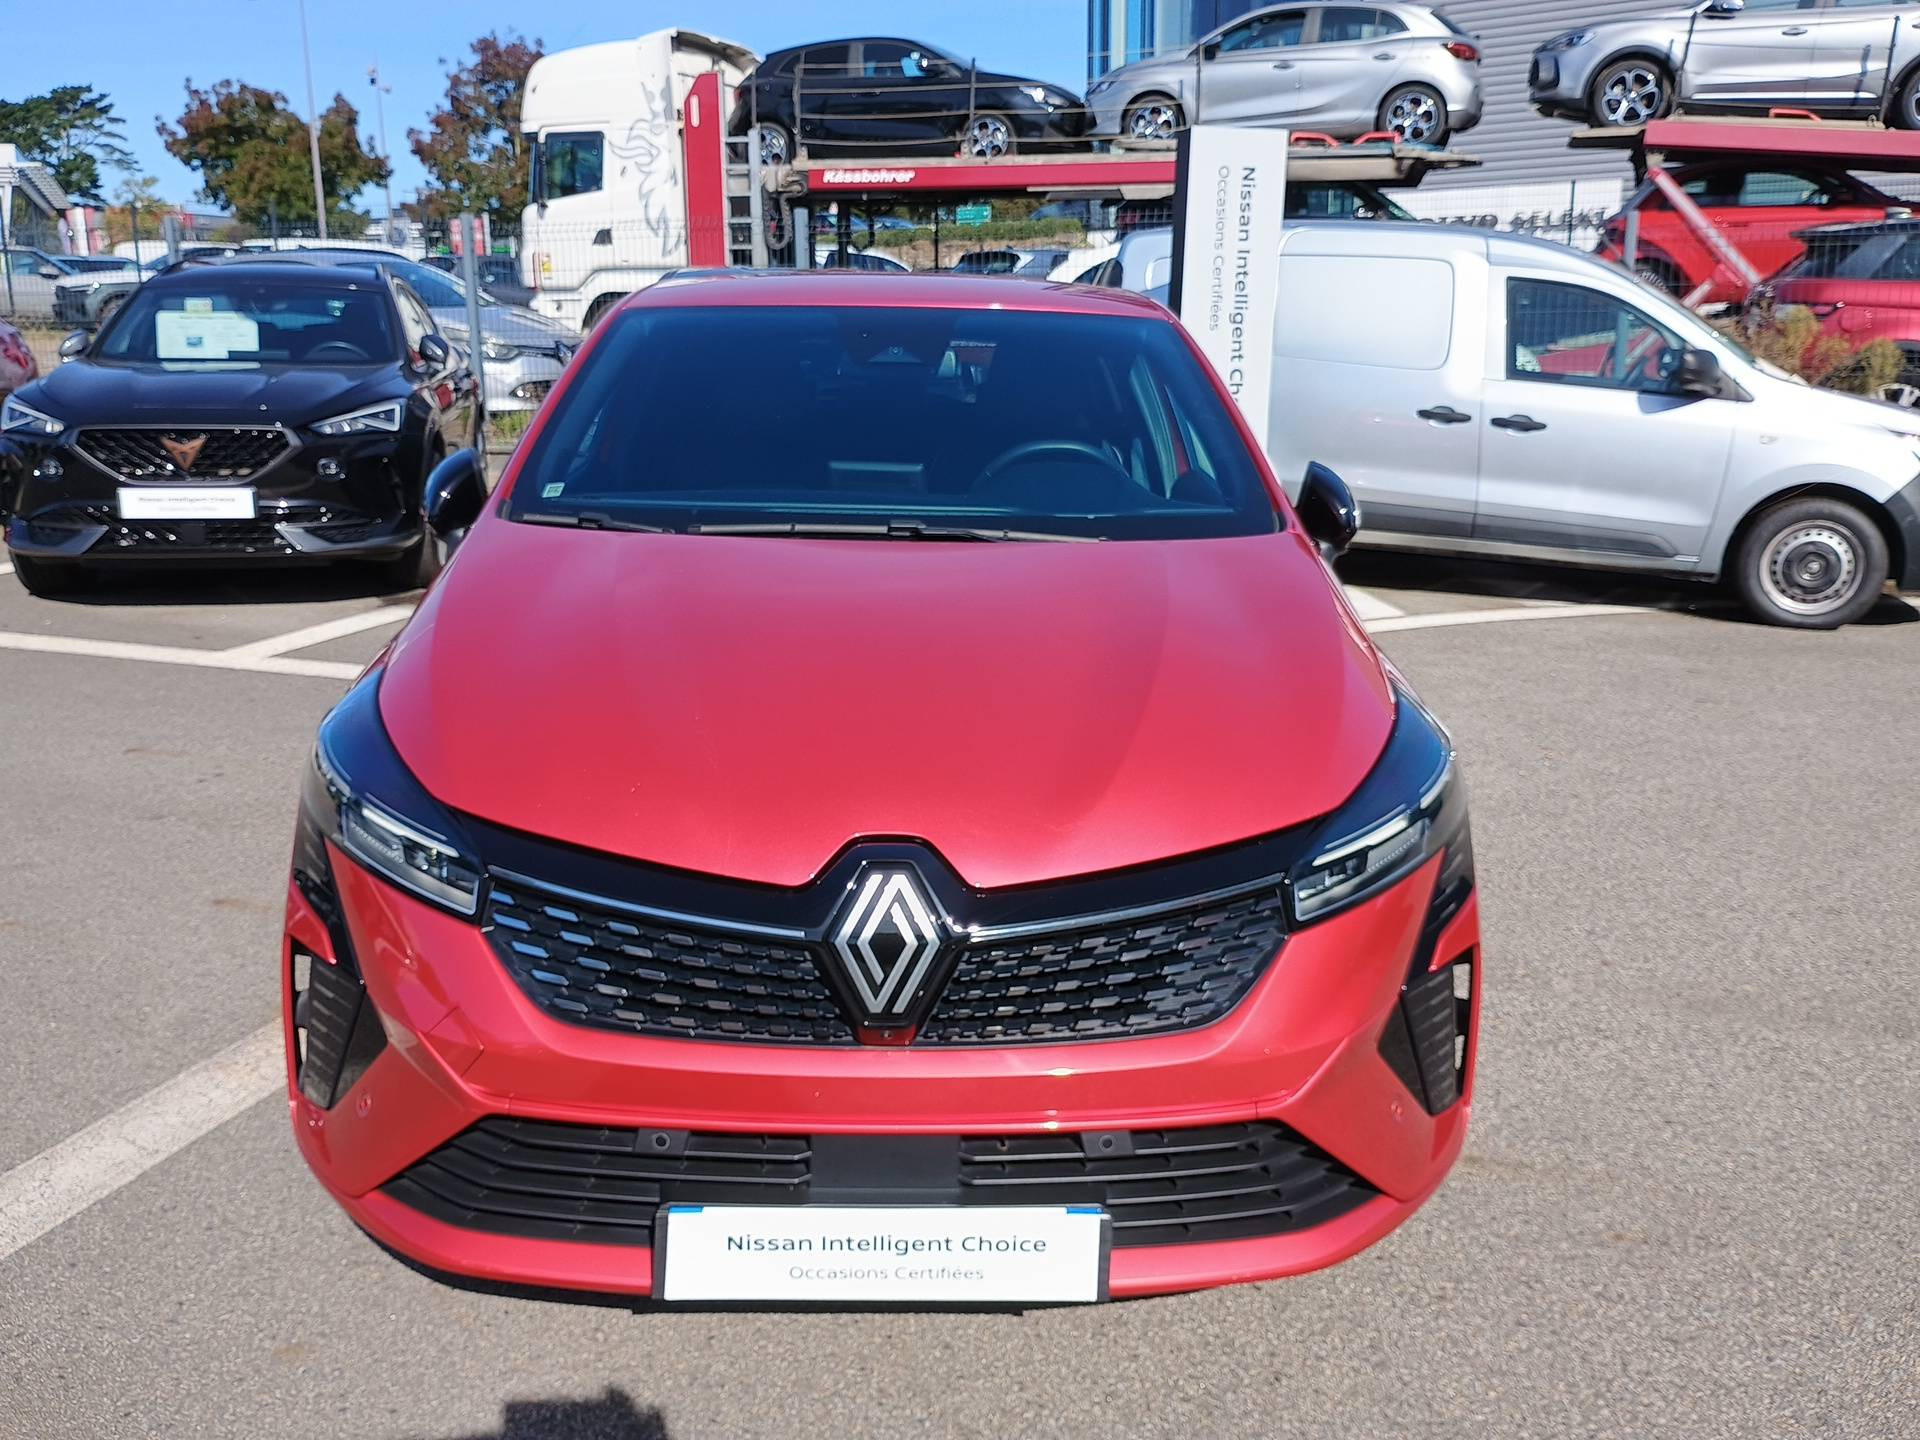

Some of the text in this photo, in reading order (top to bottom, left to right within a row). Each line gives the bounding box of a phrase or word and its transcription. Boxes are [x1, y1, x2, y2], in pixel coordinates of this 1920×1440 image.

[1213, 165, 1230, 250] Occasions
[1237, 166, 1256, 242] Nissan
[1229, 249, 1251, 363] Intelligent
[726, 1234, 1047, 1257] Nissan Intelligent Choice
[789, 1264, 985, 1280] Occasions Certifiées
